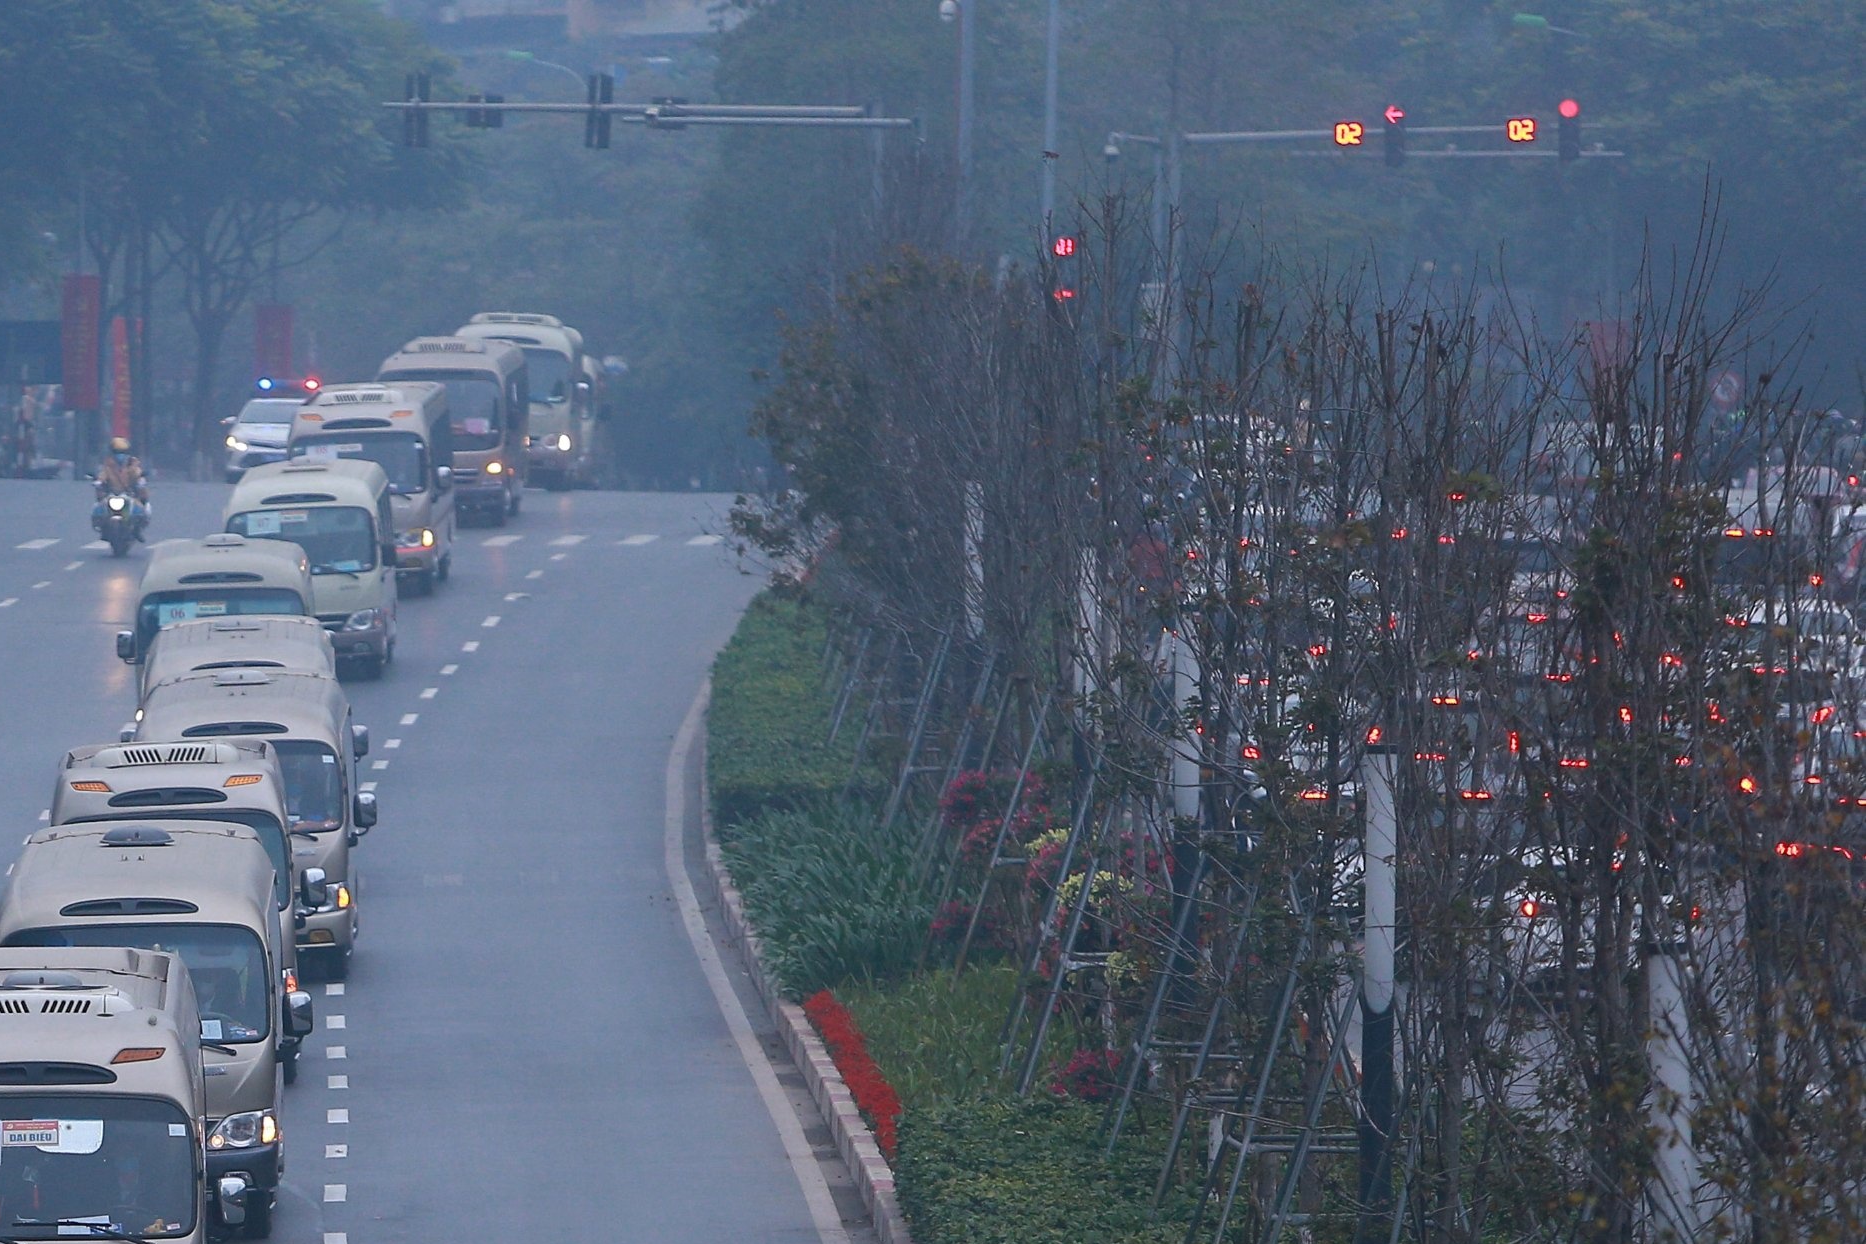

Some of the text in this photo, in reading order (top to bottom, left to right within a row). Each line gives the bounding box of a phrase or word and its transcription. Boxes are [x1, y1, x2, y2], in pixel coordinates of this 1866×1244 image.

[1335, 122, 1362, 145] 02
[1508, 119, 1534, 141] 02
[170, 608, 185, 619] 06
